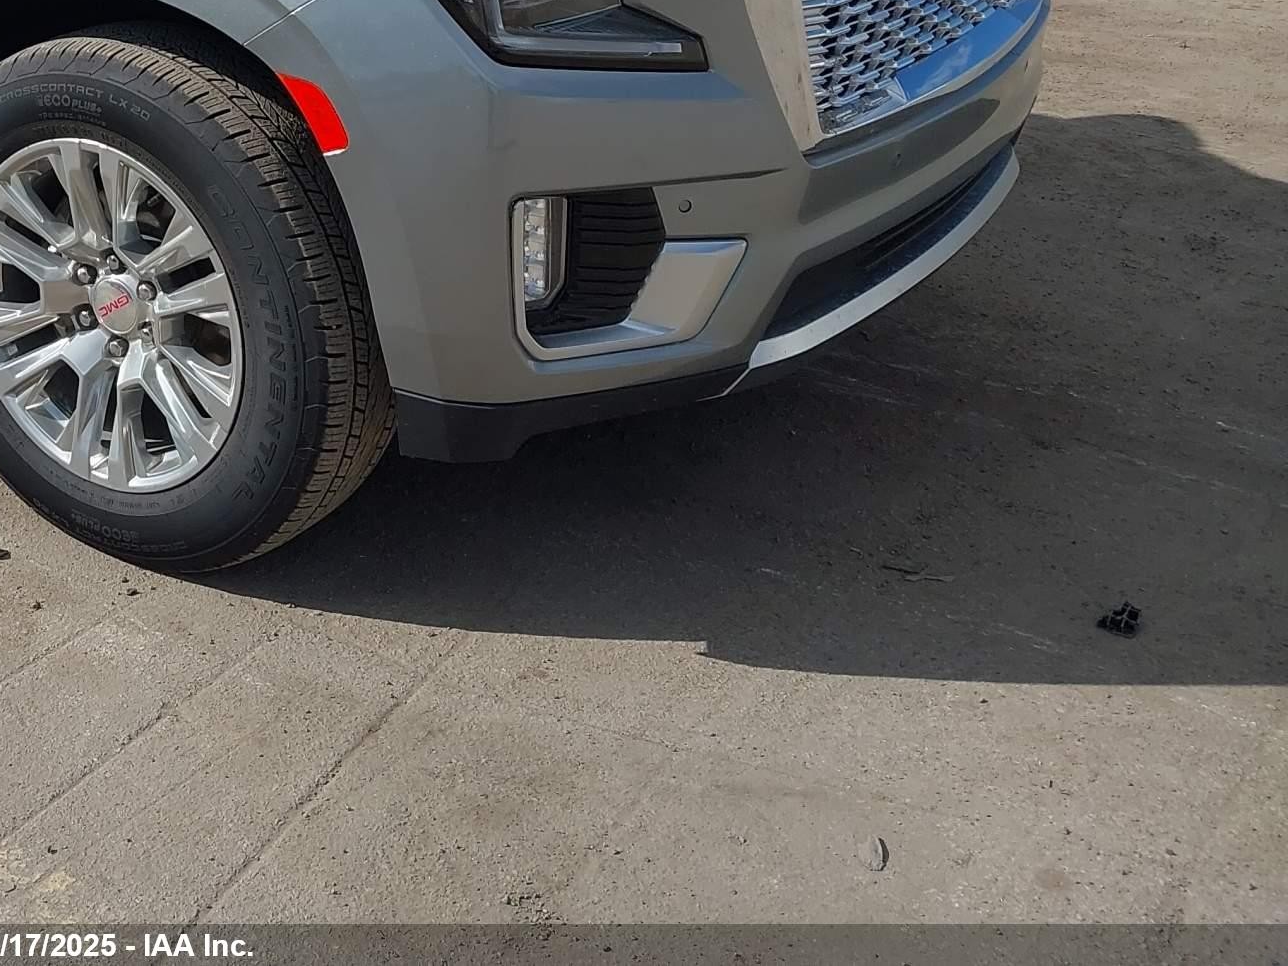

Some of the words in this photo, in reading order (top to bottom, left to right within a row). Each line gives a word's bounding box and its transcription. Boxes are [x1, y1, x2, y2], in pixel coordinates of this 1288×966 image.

[0, 83, 105, 105] CROSSCONTACT
[108, 94, 130, 110] LX
[131, 105, 152, 122] 20
[98, 294, 130, 319] GMC
[208, 185, 289, 503] CONTINENTAL
